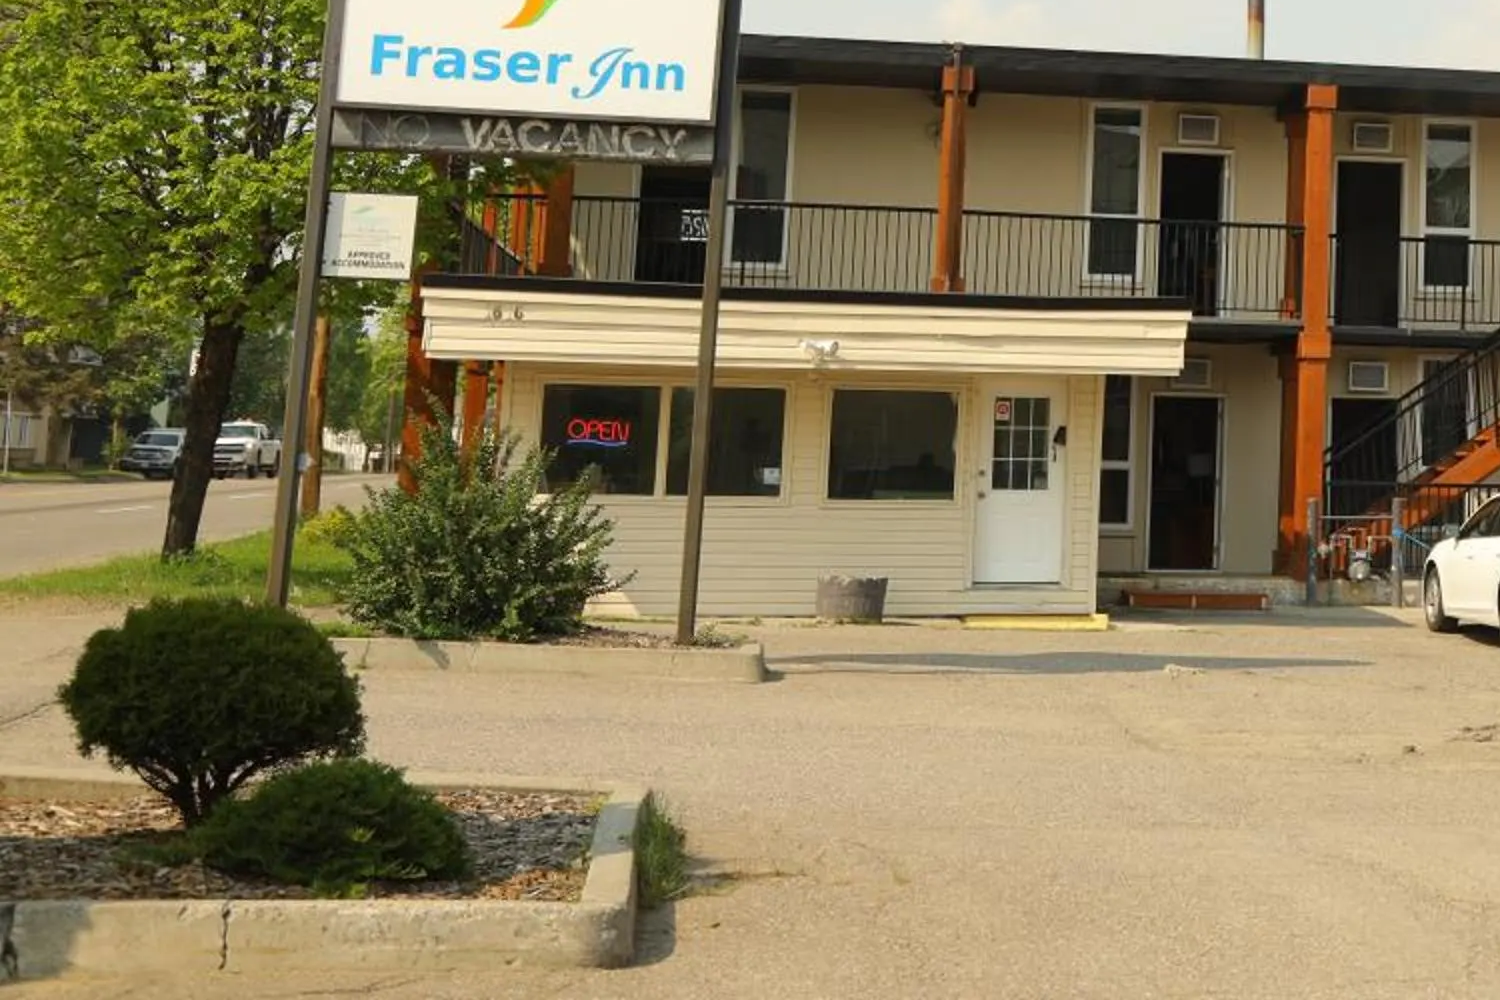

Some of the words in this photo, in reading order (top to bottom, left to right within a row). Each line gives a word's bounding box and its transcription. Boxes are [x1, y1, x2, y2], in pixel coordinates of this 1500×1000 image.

[370, 34, 573, 84] Fraser
[571, 47, 686, 100] Inn
[461, 117, 687, 159] VACANCY
[567, 419, 629, 440] OPEN
